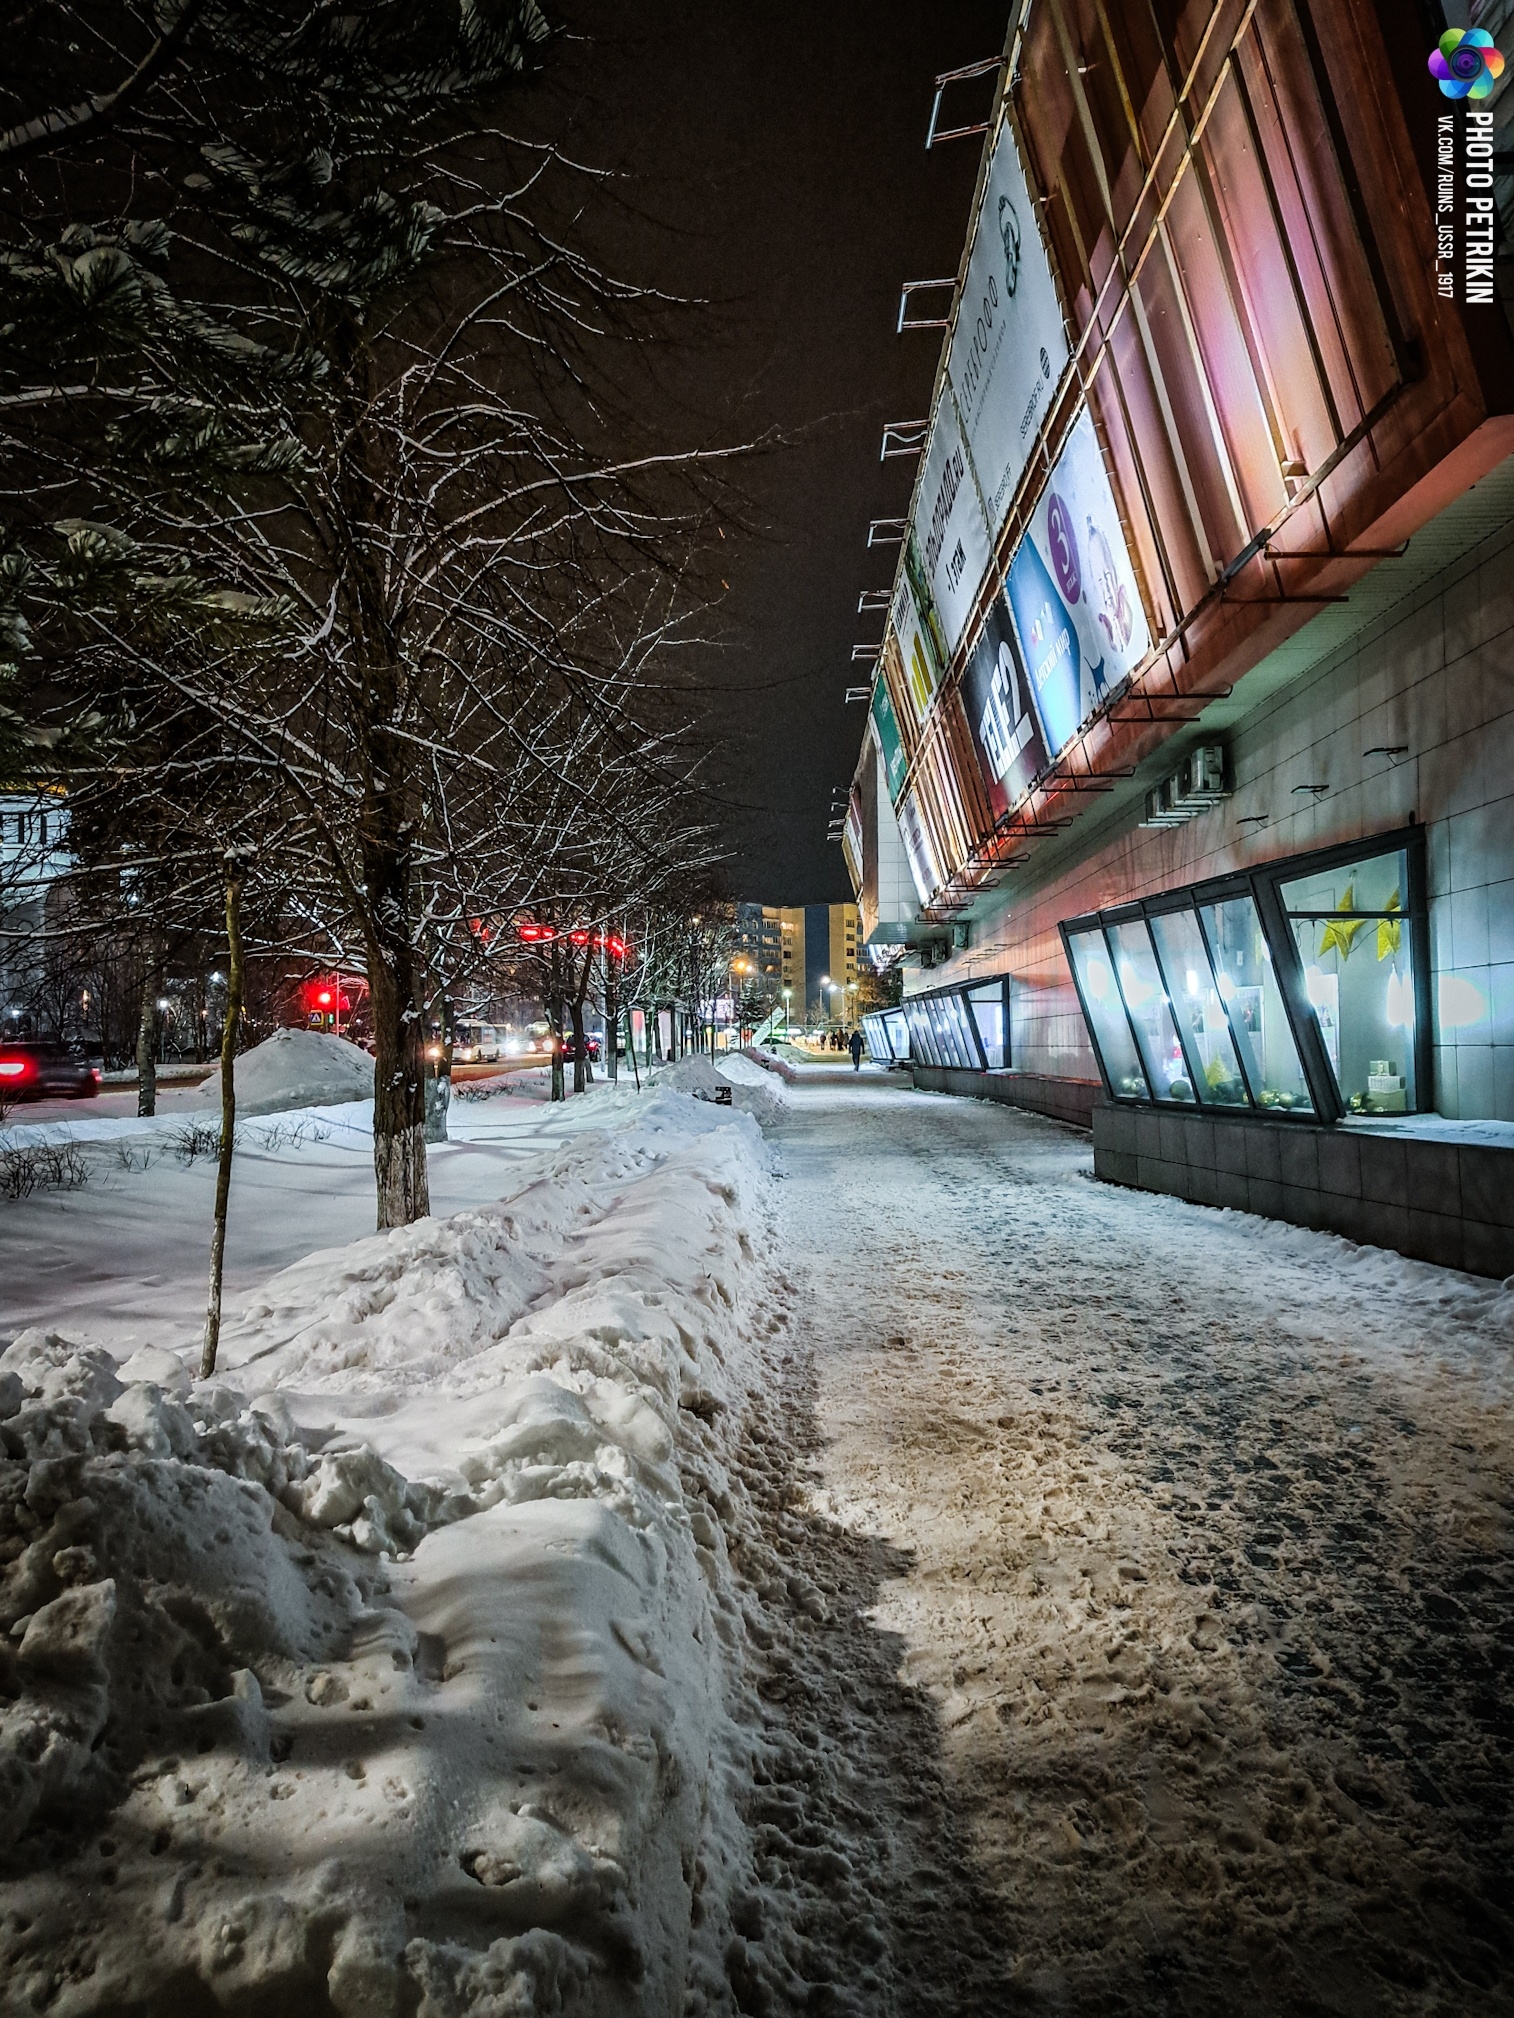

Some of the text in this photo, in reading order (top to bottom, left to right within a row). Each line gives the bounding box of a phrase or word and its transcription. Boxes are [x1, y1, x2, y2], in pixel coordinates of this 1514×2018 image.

[959, 275, 998, 424] СЕРЕБРОФФ
[1051, 508, 1070, 575] 3
[978, 640, 1035, 786] TELE2
